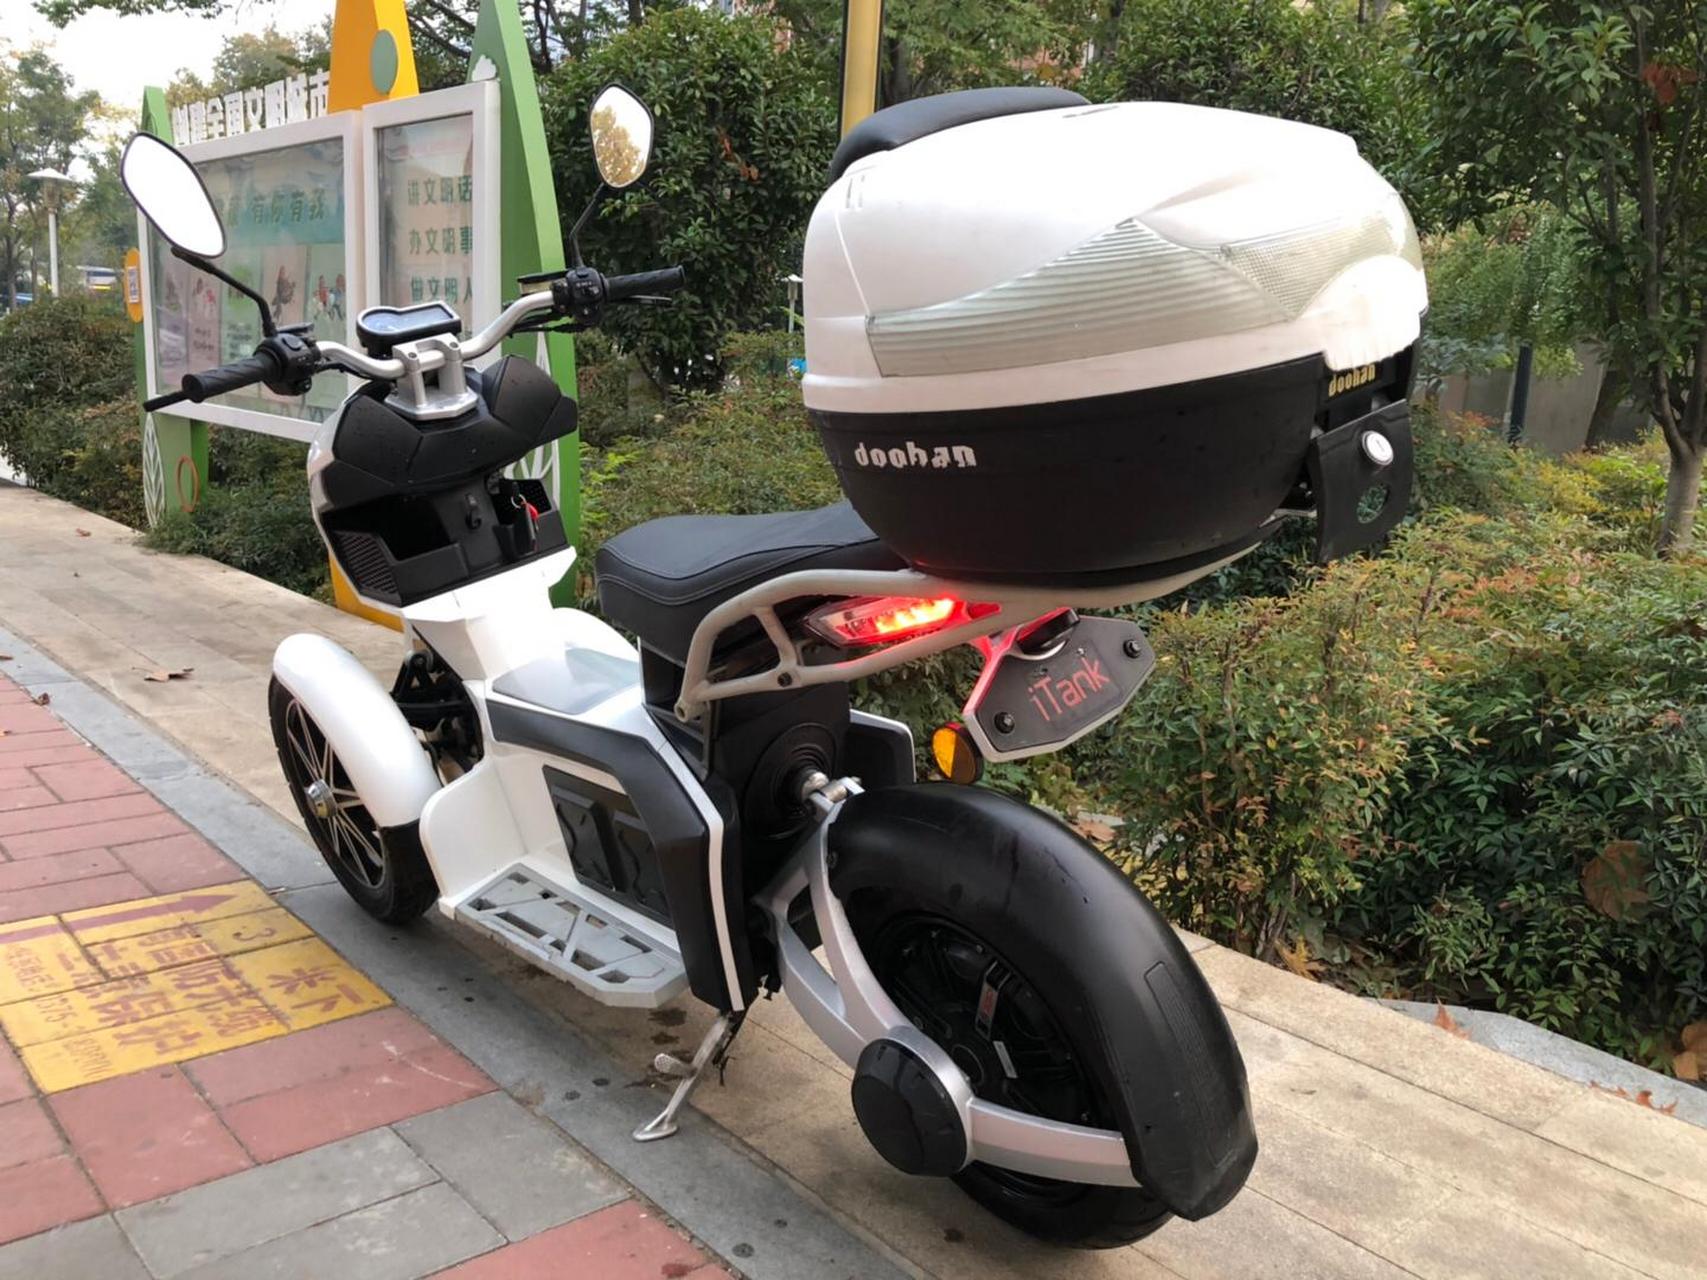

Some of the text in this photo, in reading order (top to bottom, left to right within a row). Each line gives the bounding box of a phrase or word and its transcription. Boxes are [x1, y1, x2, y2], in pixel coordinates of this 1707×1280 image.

[1328, 362, 1376, 398] doohan
[854, 441, 977, 468] doohan
[1027, 656, 1111, 721] iTank
